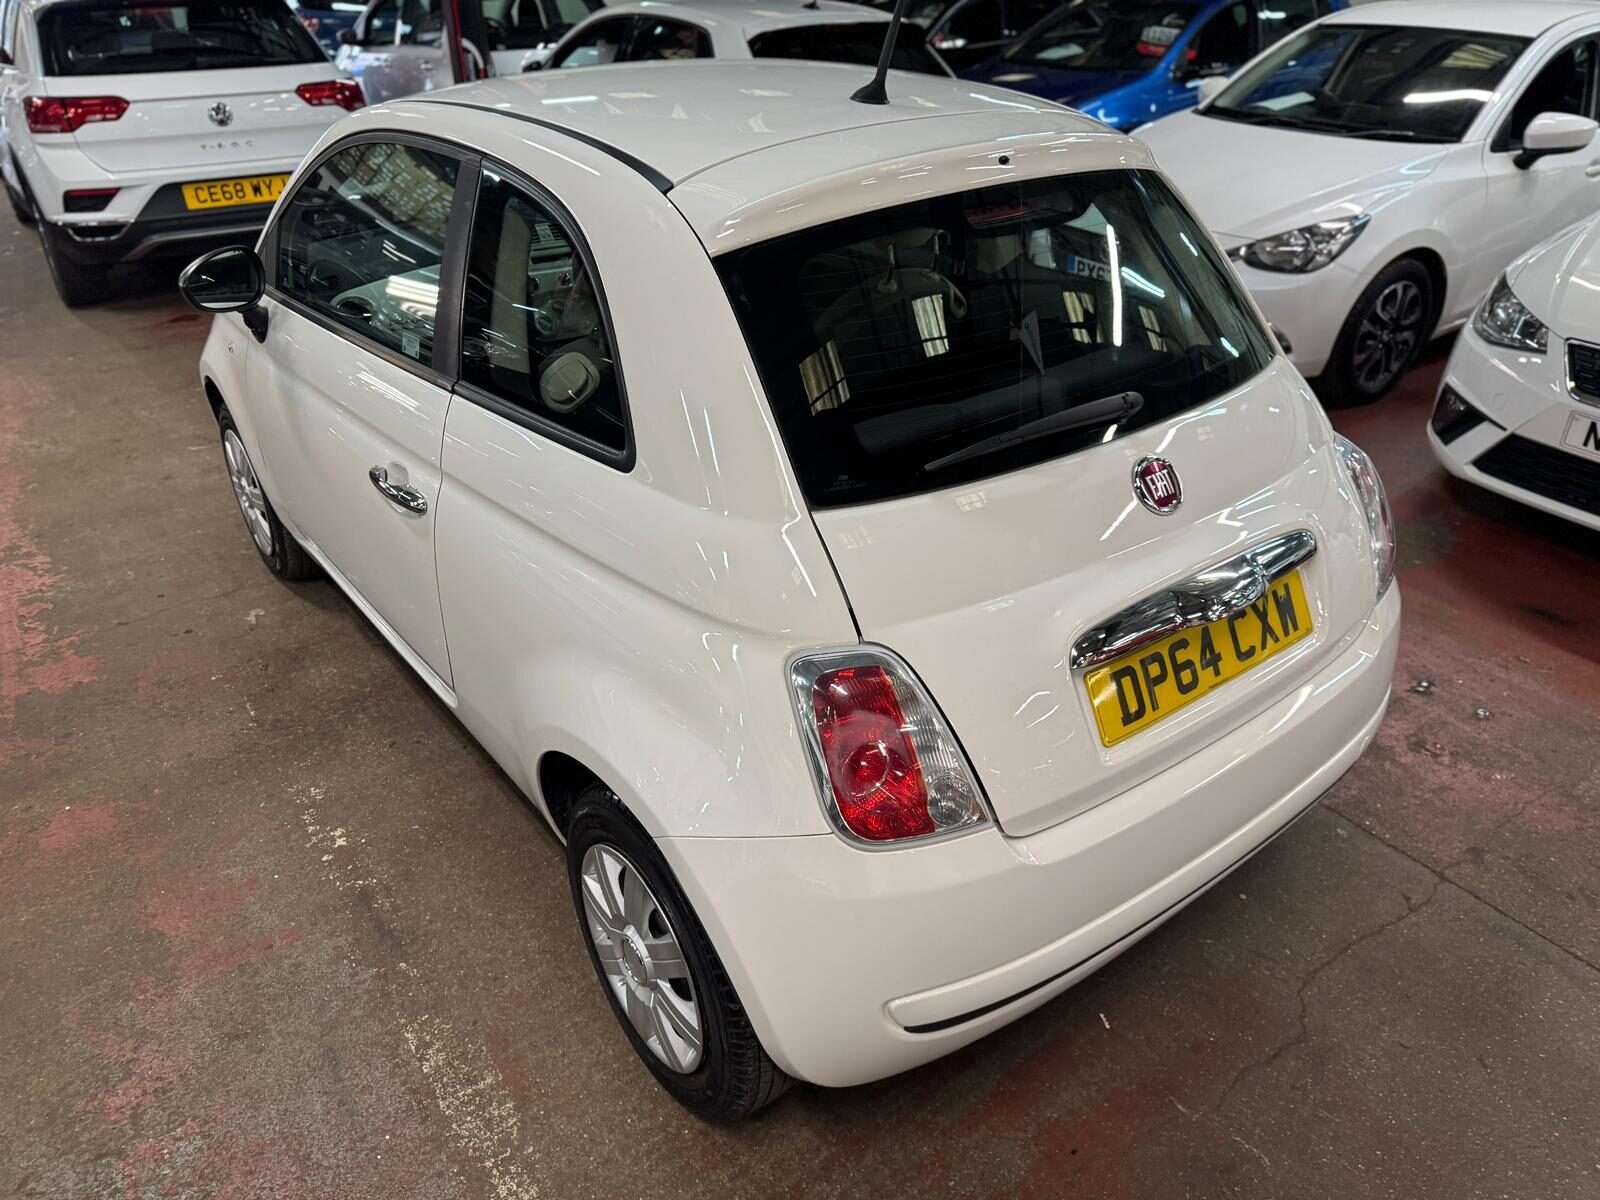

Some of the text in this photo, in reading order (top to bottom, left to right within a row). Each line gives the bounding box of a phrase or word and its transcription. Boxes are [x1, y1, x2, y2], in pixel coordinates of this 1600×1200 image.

[193, 182, 247, 204] CE68
[1145, 469, 1175, 500] FIAT
[1112, 583, 1299, 727] DP64 CXW
